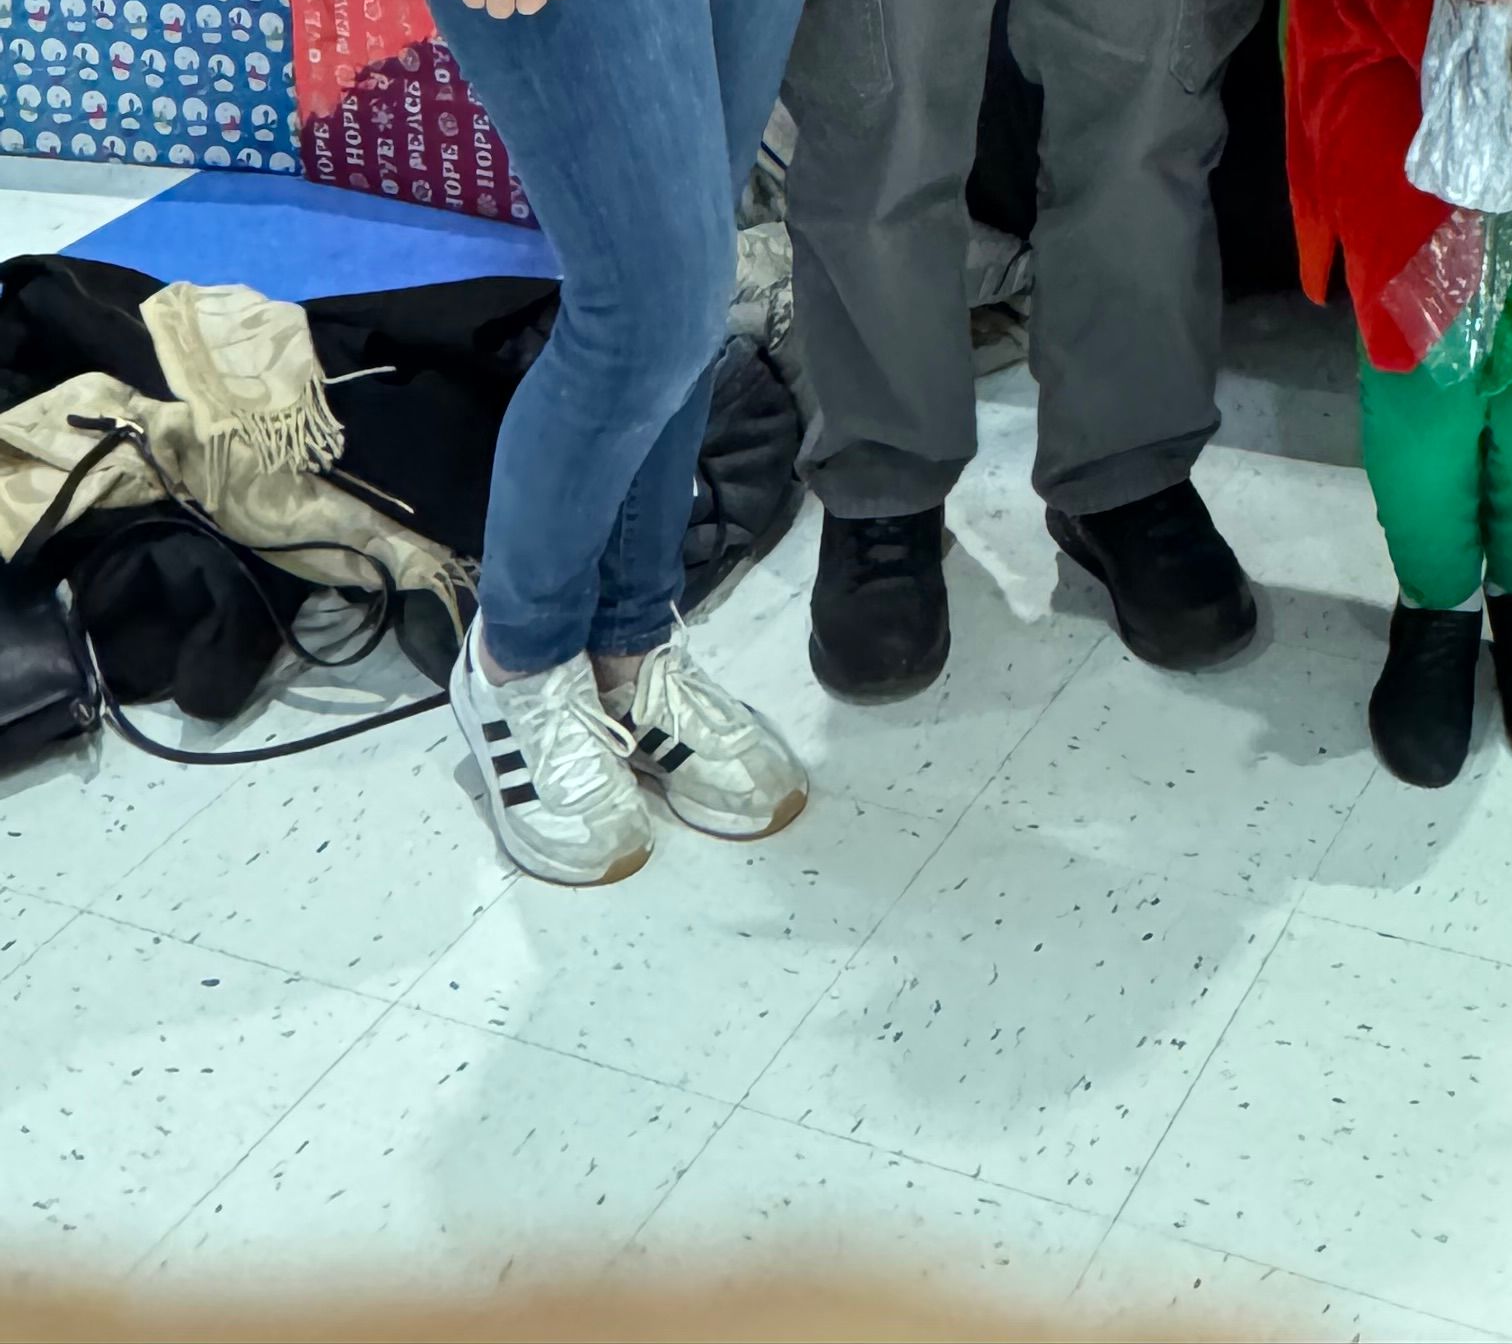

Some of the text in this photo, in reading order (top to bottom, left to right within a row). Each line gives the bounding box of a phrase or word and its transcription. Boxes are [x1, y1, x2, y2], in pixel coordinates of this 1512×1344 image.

[304, 9, 322, 64] OVE
[342, 94, 365, 166] HOPE
[403, 80, 427, 171] PEACE
[473, 113, 495, 188] HOPE
[377, 137, 400, 195] OVE
